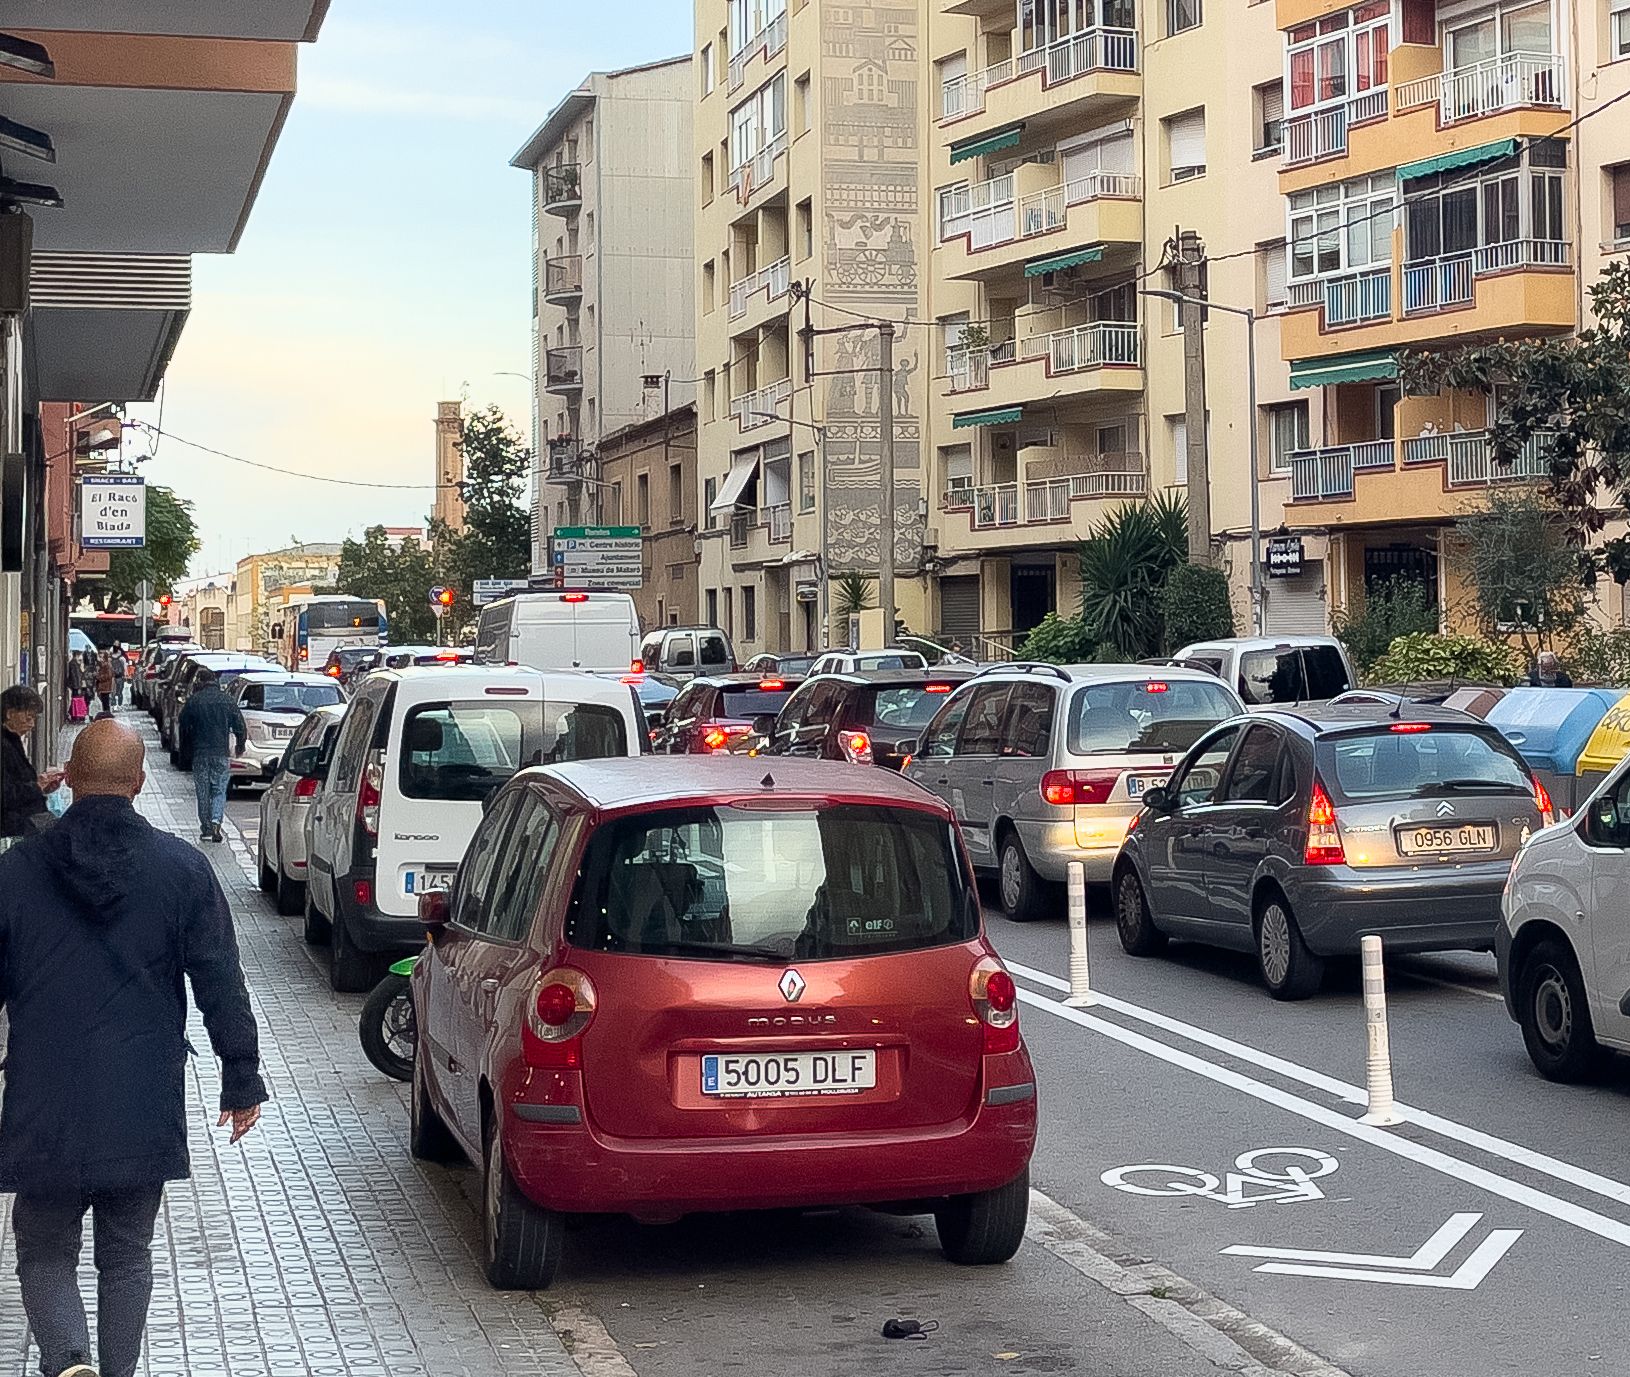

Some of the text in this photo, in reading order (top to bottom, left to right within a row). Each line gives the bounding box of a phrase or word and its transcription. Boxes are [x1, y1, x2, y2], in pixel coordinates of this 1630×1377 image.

[91, 493, 102, 502] El
[100, 506, 128, 517] d'en
[1415, 830, 1487, 848] 0956 GLN
[724, 1057, 800, 1087] 5005
[812, 1055, 867, 1084] DLF
